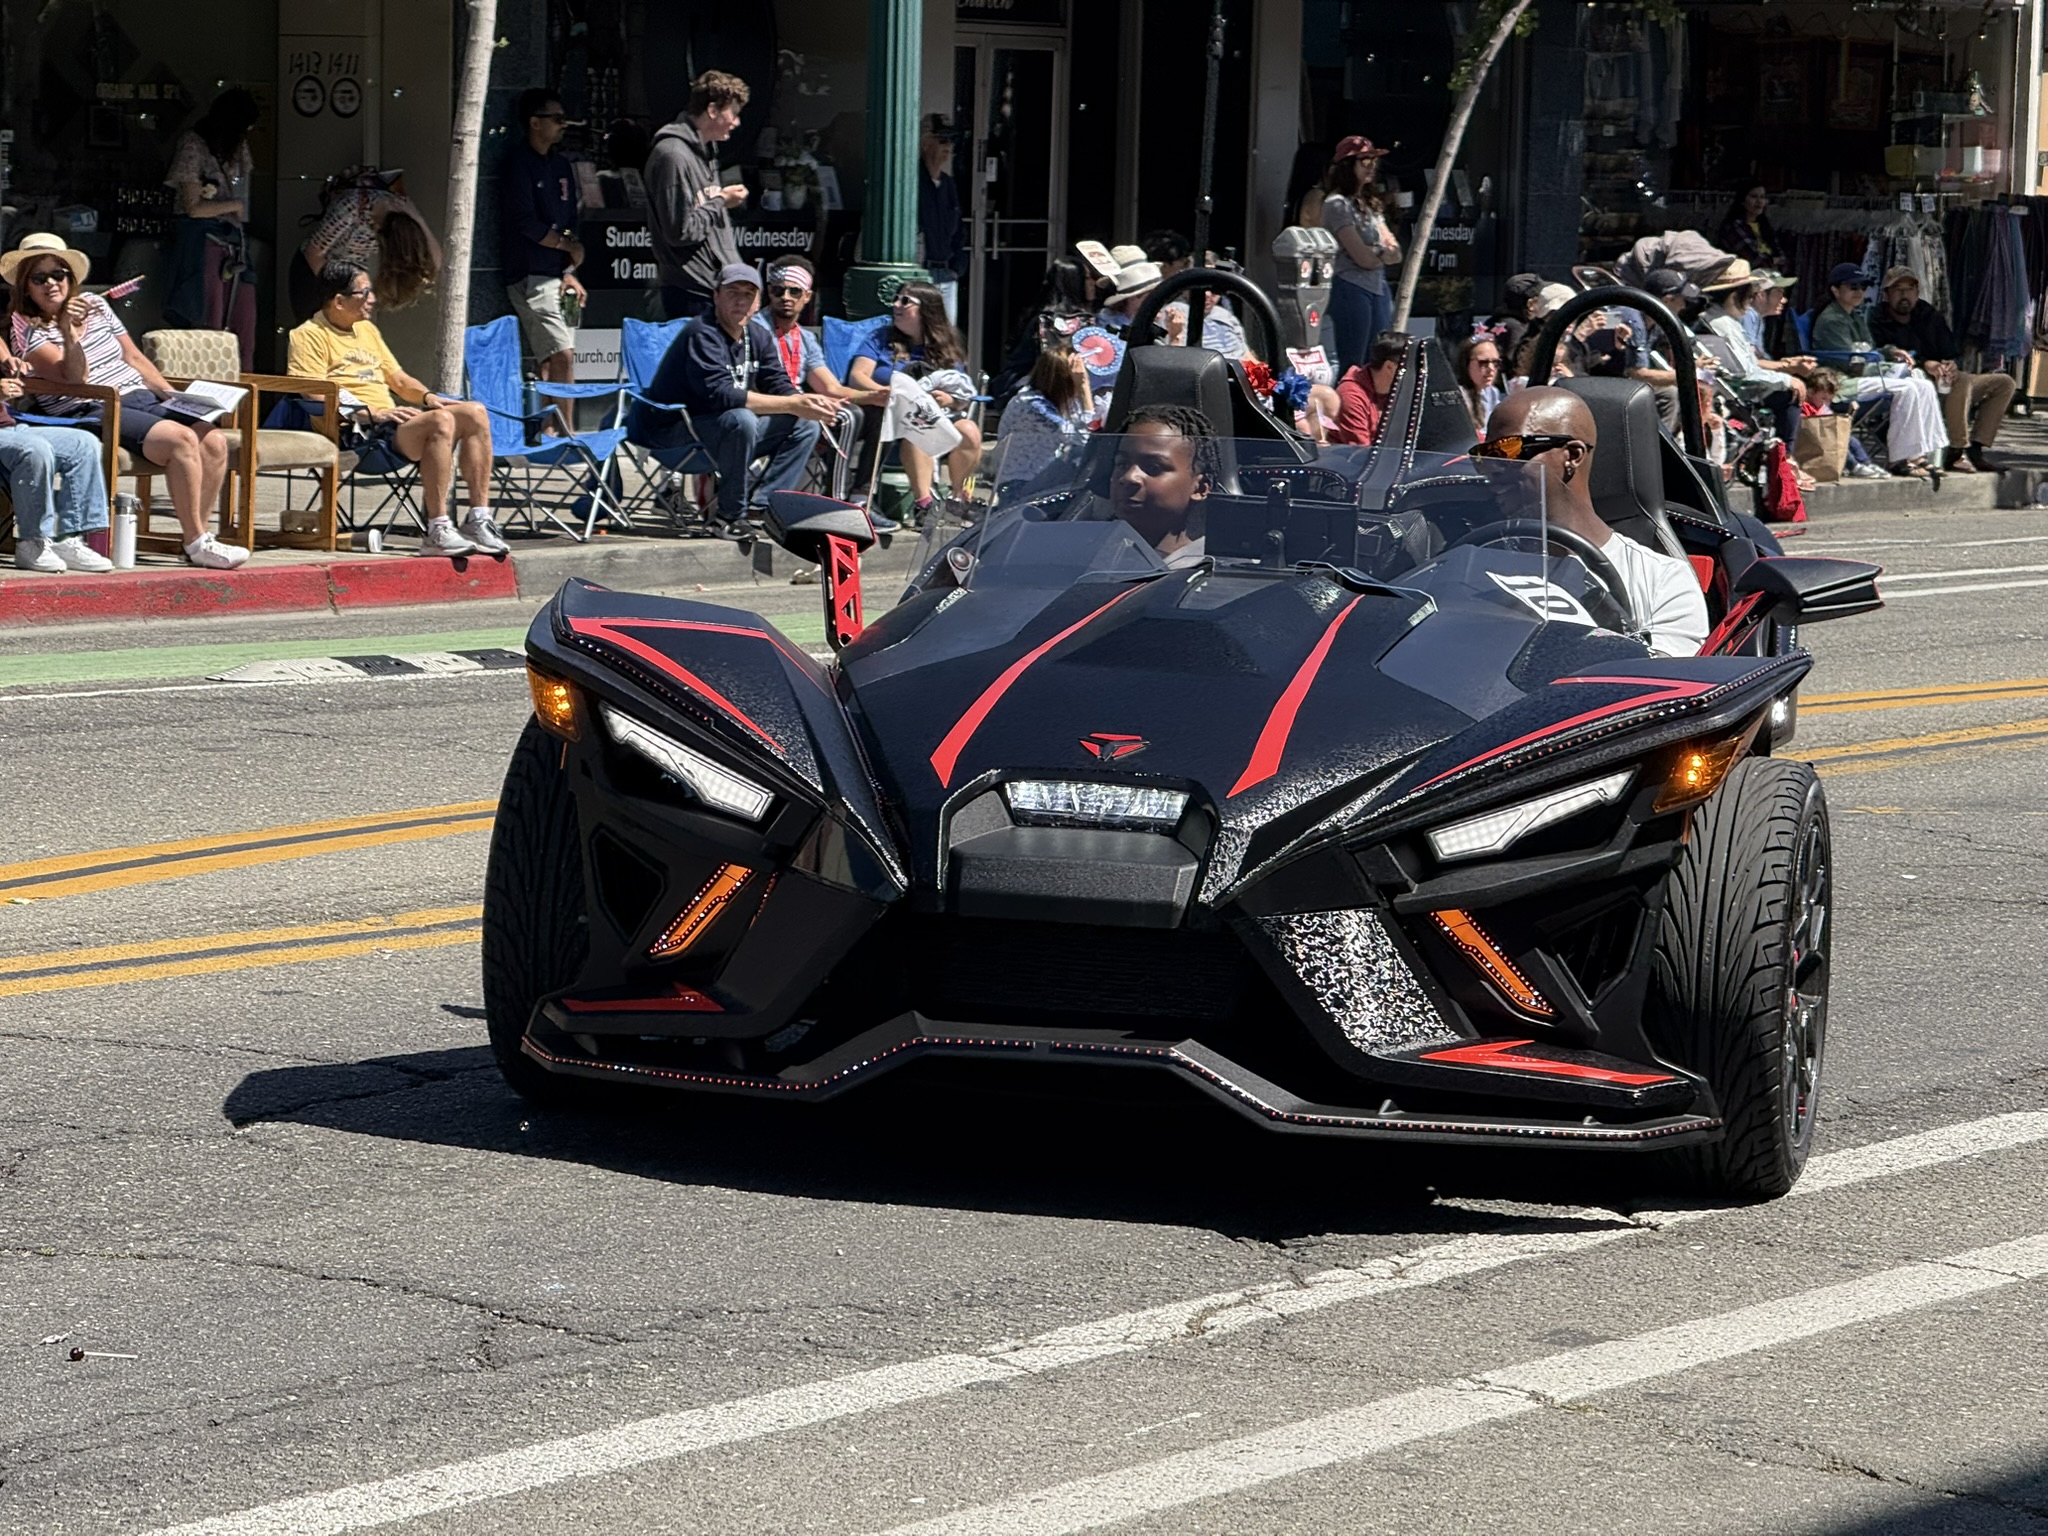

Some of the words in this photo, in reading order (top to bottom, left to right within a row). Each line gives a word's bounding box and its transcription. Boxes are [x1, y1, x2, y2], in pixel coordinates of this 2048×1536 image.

[289, 51, 322, 75] 1413
[327, 53, 359, 75] 1411
[605, 225, 653, 248] Sunda
[1411, 222, 1475, 245] Wdnesday
[610, 257, 631, 279] 10
[632, 262, 658, 279] am
[754, 257, 765, 279] 7
[1429, 249, 1438, 267] 7
[1437, 253, 1457, 272] pm
[1506, 580, 1579, 616] 10
